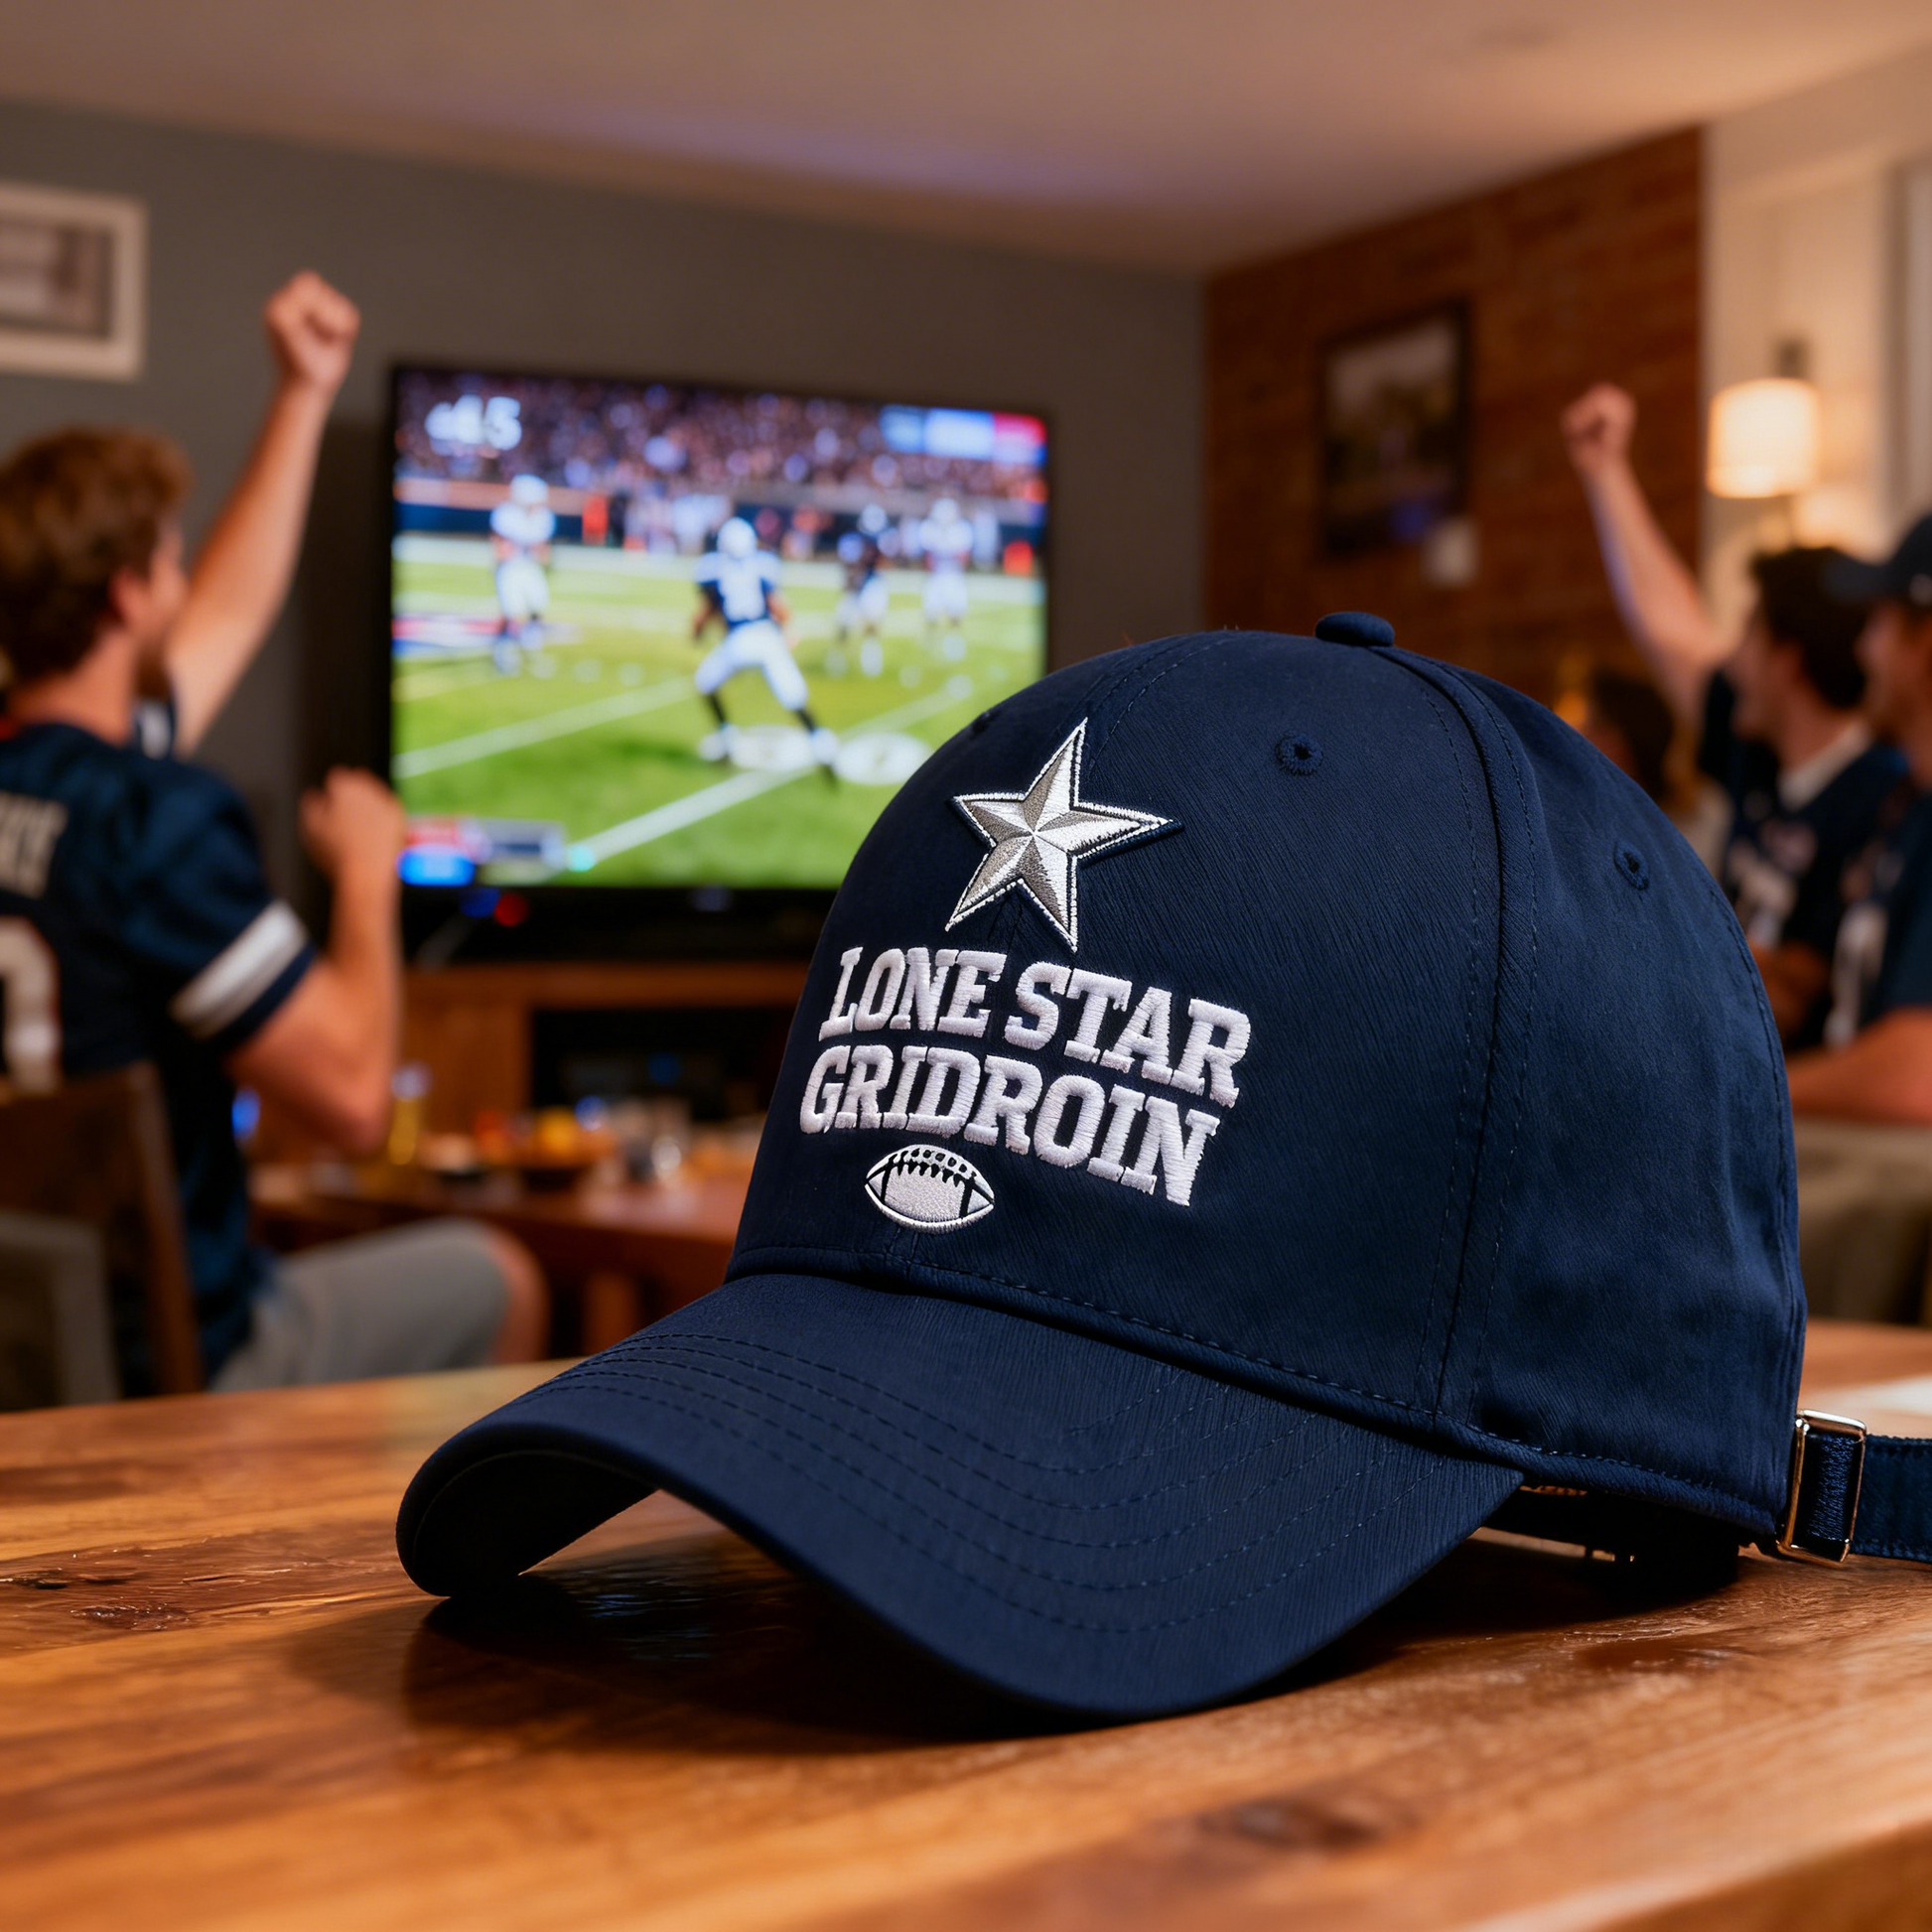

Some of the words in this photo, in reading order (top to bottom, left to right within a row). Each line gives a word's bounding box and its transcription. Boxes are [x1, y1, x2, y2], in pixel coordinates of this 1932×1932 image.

[818, 946, 1008, 1041] LONE
[1004, 961, 1252, 1108] STAR
[799, 1044, 1221, 1207] GRIDROIN
